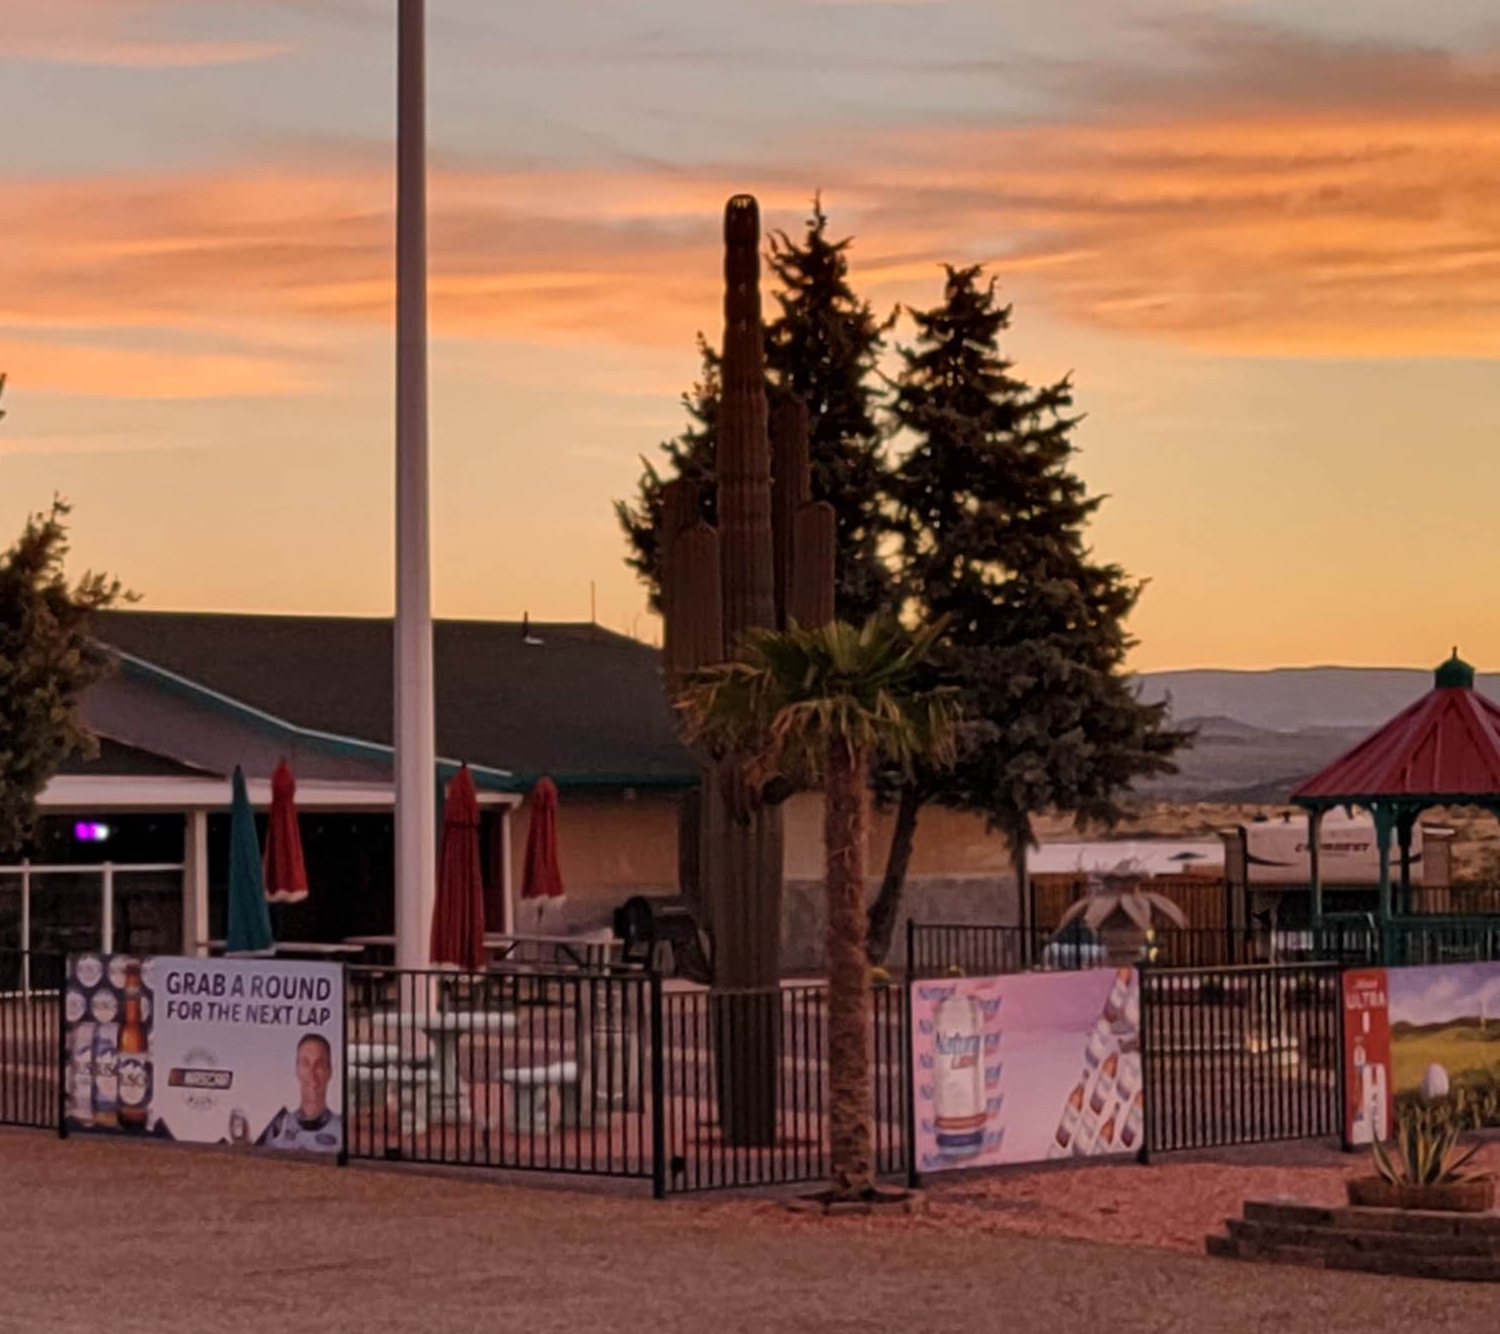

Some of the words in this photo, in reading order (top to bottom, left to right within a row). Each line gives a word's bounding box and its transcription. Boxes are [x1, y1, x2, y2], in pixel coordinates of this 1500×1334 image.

[166, 971, 226, 996] GRAB
[230, 974, 245, 998] A
[251, 975, 331, 1001] ROUND
[167, 1001, 203, 1020] FOR
[208, 1002, 242, 1022] THE
[245, 1004, 293, 1025] NEXT
[297, 1007, 331, 1026] LAP
